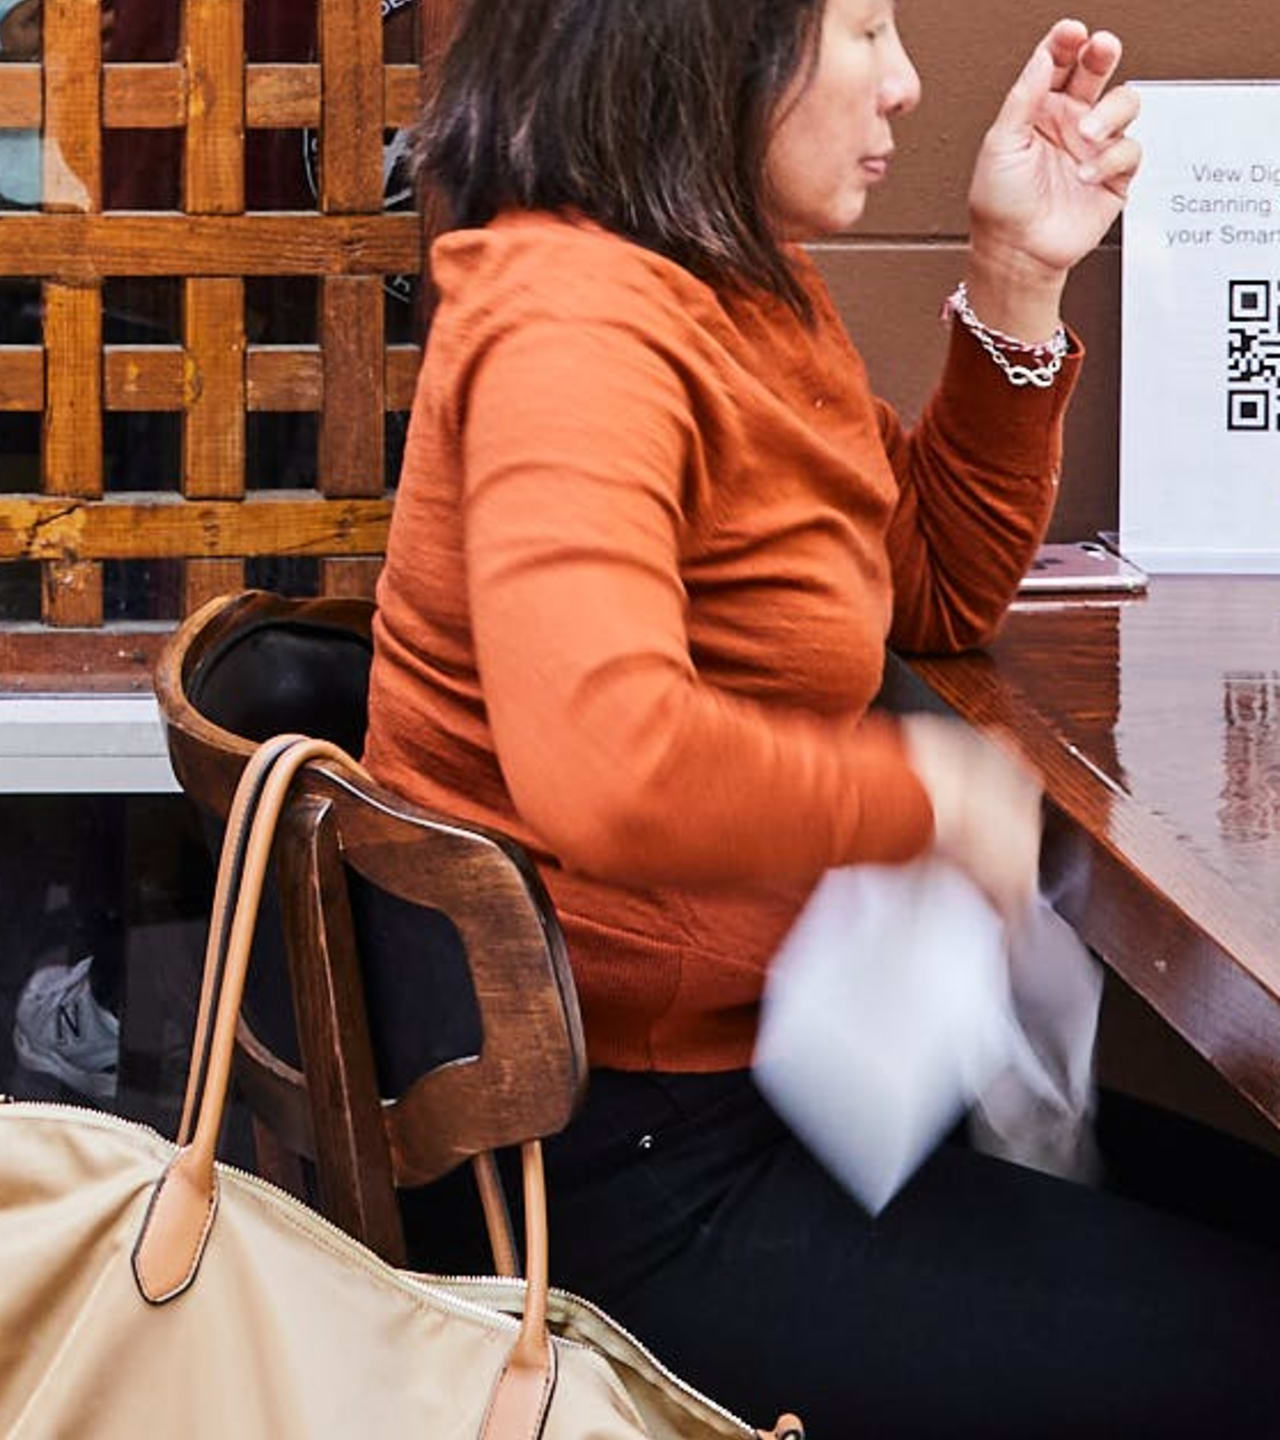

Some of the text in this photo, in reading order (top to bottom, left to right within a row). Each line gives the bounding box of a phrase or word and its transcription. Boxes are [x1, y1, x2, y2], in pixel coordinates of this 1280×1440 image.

[1192, 164, 1241, 182] View
[1171, 195, 1272, 217] Scanning
[1166, 229, 1211, 246] your
[57, 1003, 80, 1039] N
